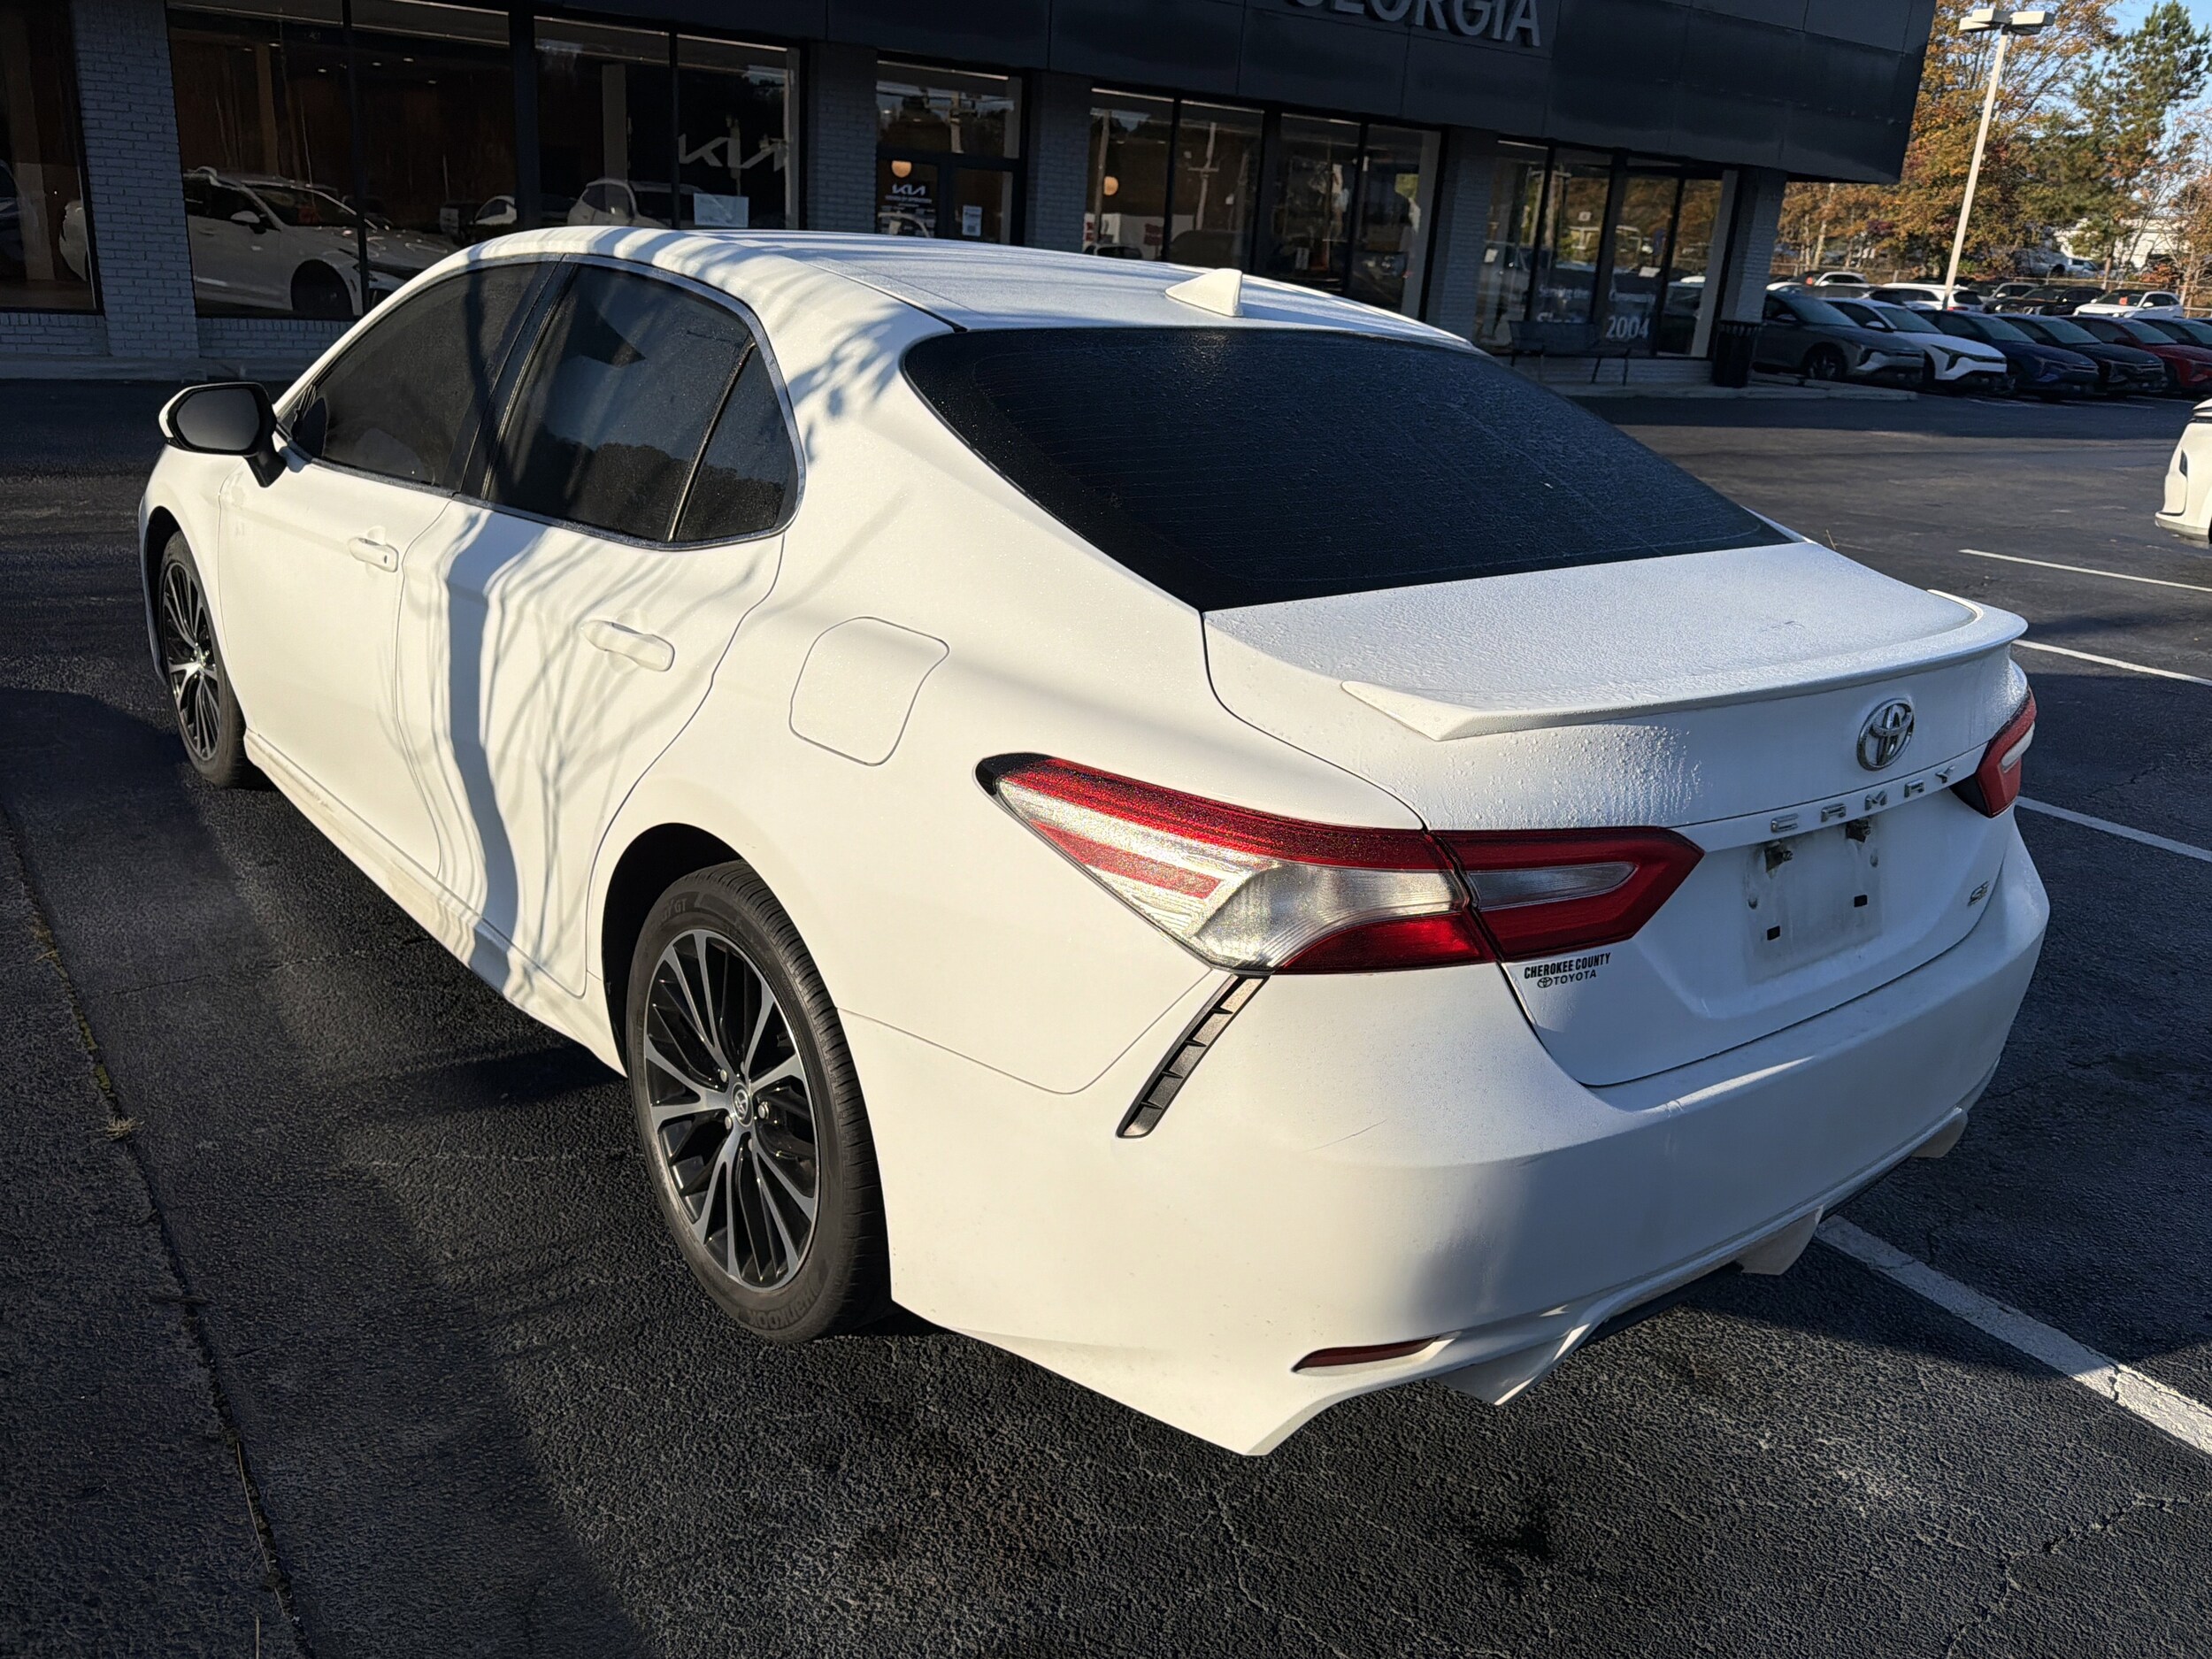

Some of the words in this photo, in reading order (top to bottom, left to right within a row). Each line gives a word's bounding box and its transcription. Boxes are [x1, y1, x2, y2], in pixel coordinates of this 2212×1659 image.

[1283, 0, 1541, 47] RGIA
[678, 134, 787, 173] KIA
[892, 182, 926, 196] KIA
[1606, 315, 1650, 340] 2004
[1770, 764, 1955, 833] CAMRY
[1524, 959, 1574, 979] CHEROKEE
[1575, 952, 1611, 971] COUNTY
[1554, 970, 1596, 985] TOYOTA
